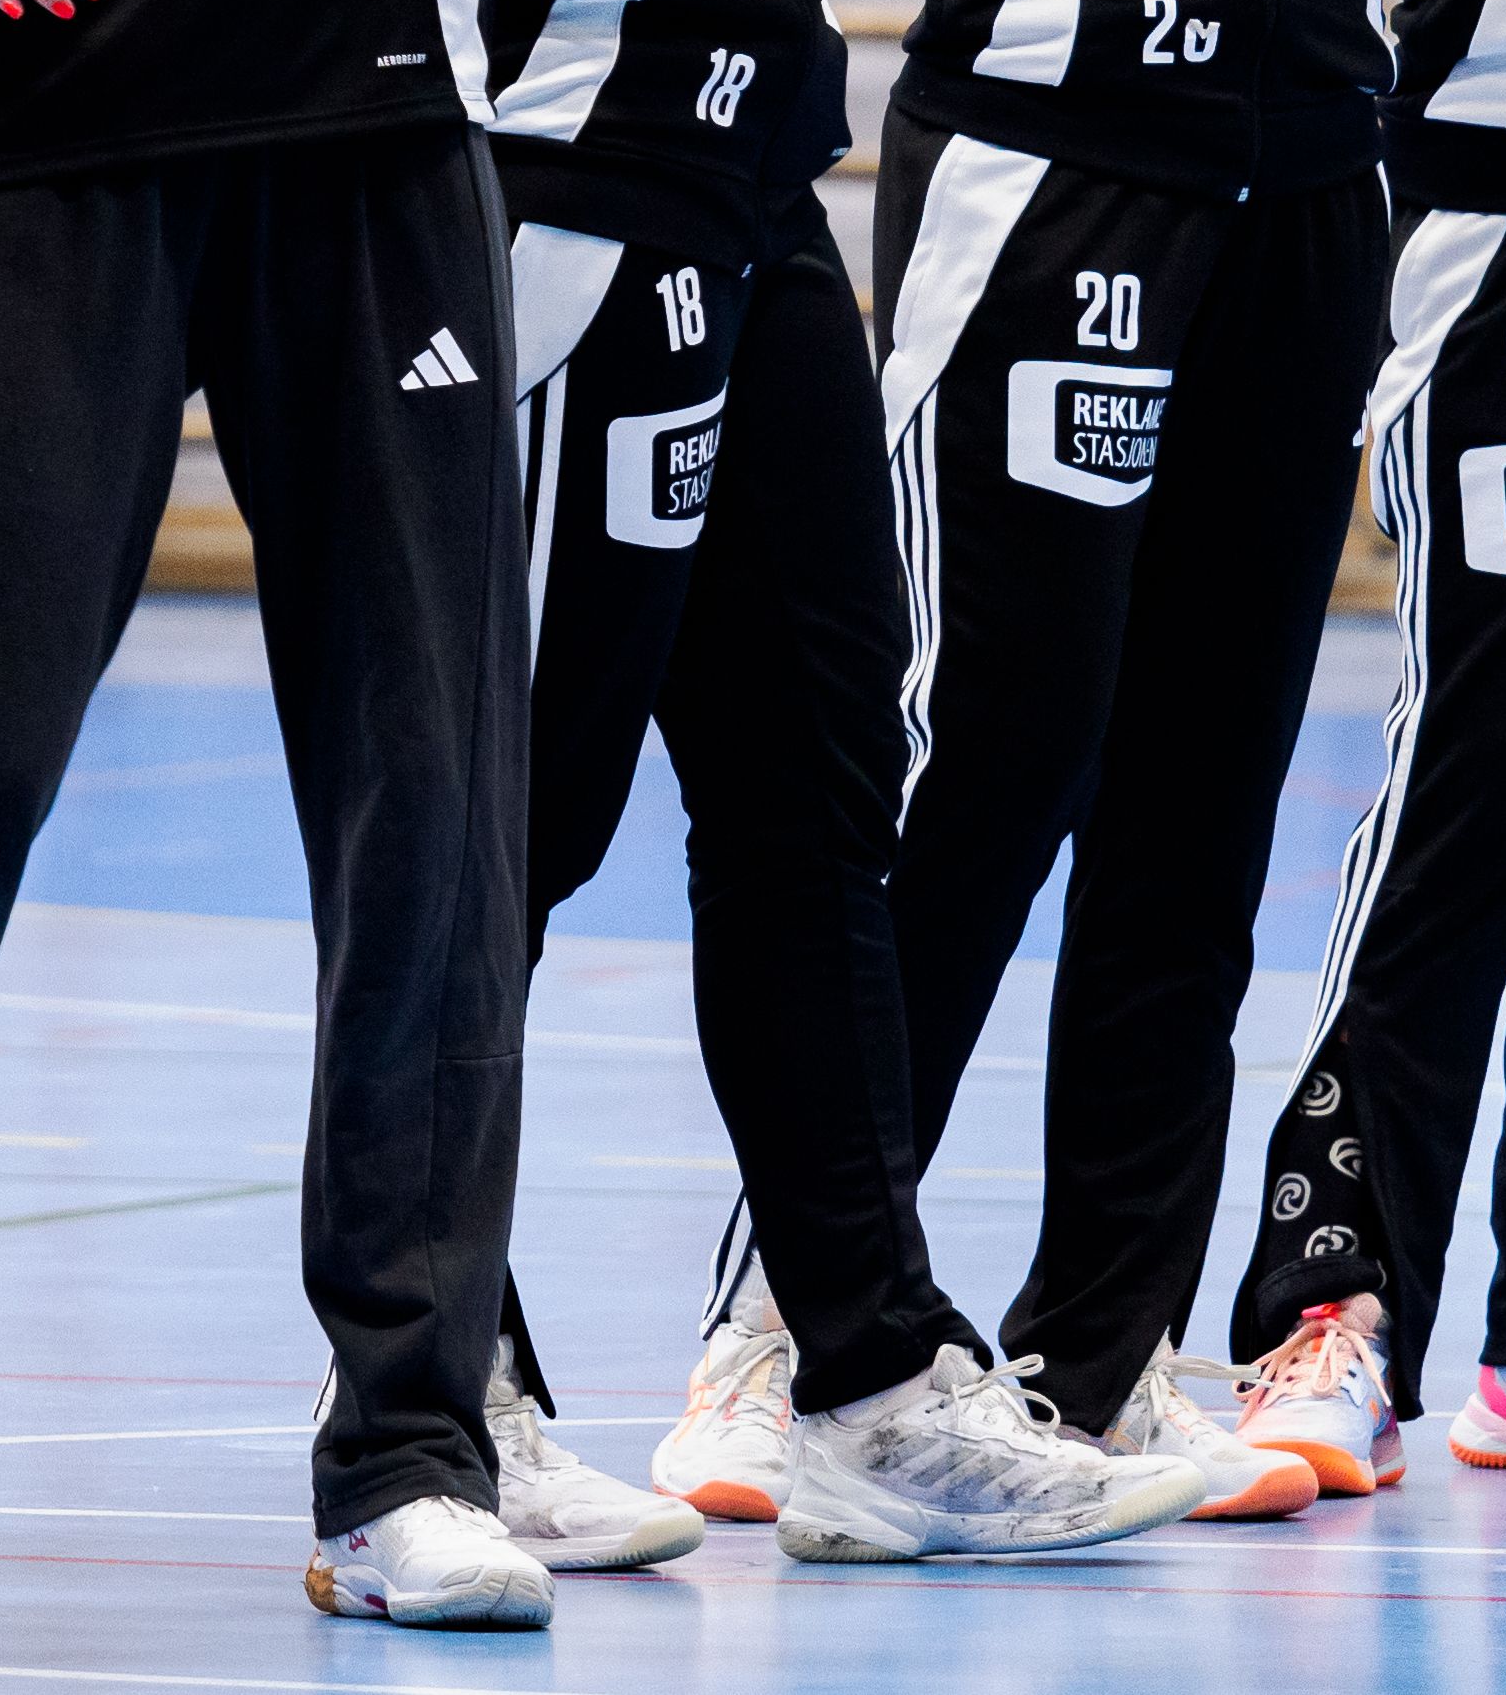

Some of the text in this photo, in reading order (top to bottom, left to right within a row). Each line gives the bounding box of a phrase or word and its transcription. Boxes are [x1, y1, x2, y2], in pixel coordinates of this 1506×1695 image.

[695, 48, 755, 128] 18
[655, 266, 706, 352] 18
[1075, 270, 1141, 351] 20
